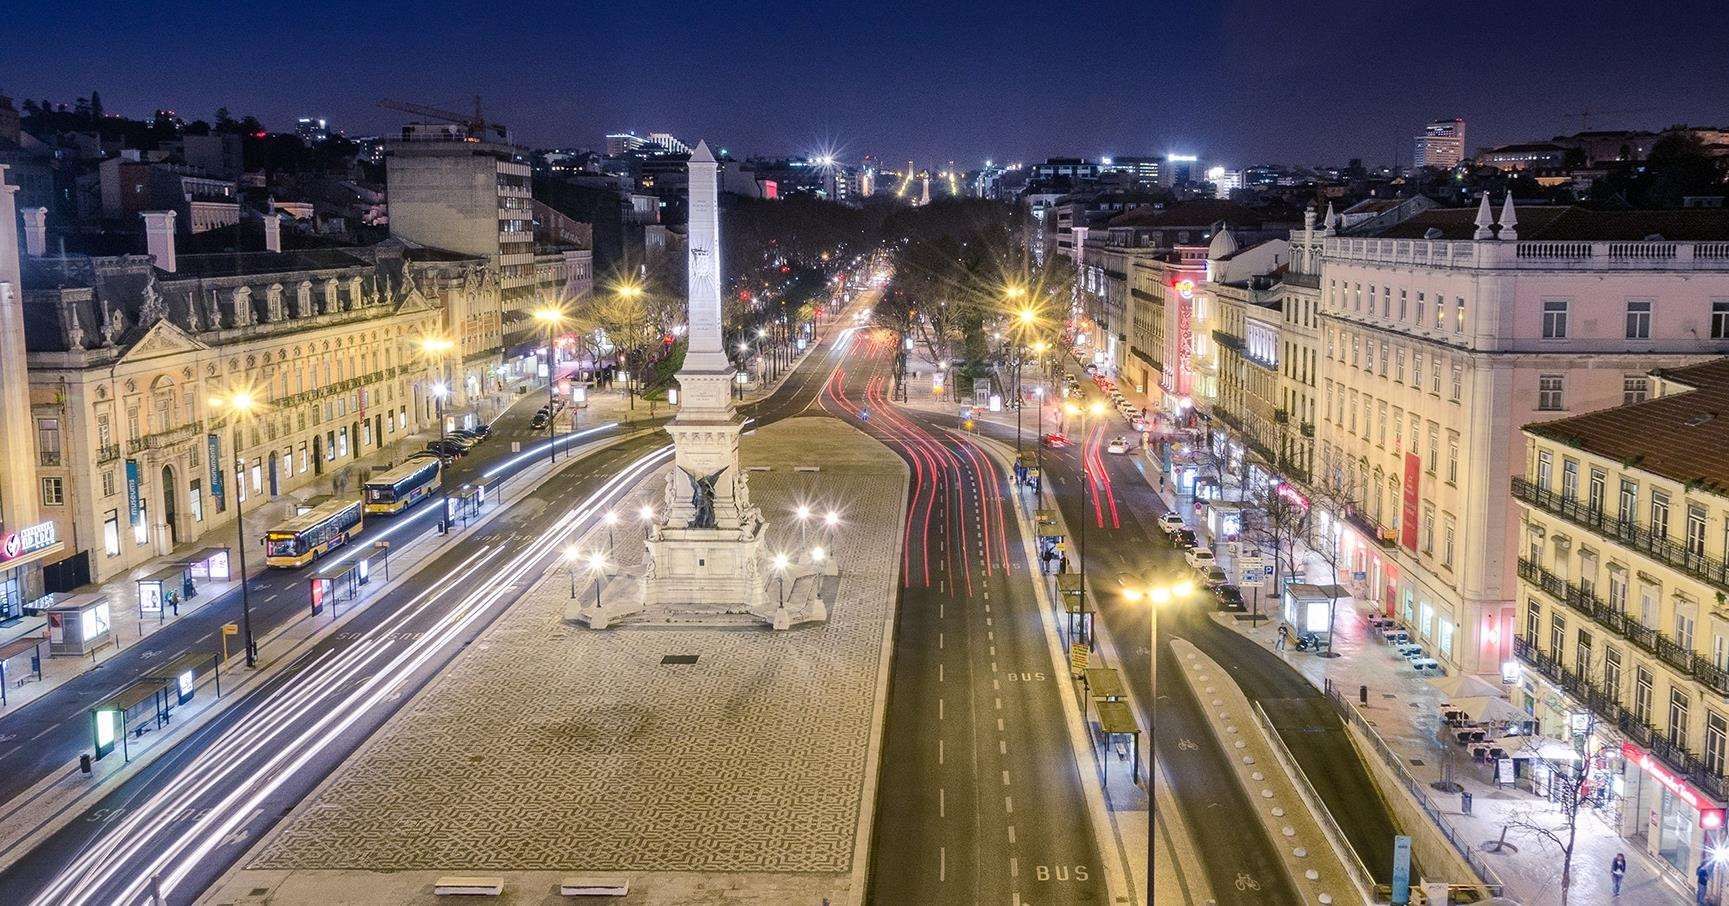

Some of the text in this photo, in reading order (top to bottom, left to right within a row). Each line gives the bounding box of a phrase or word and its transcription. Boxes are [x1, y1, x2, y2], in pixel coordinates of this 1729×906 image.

[211, 444, 219, 485] monuments
[129, 479, 138, 515] museums
[1008, 672, 1046, 682] BUS
[1036, 865, 1089, 881] BUS
